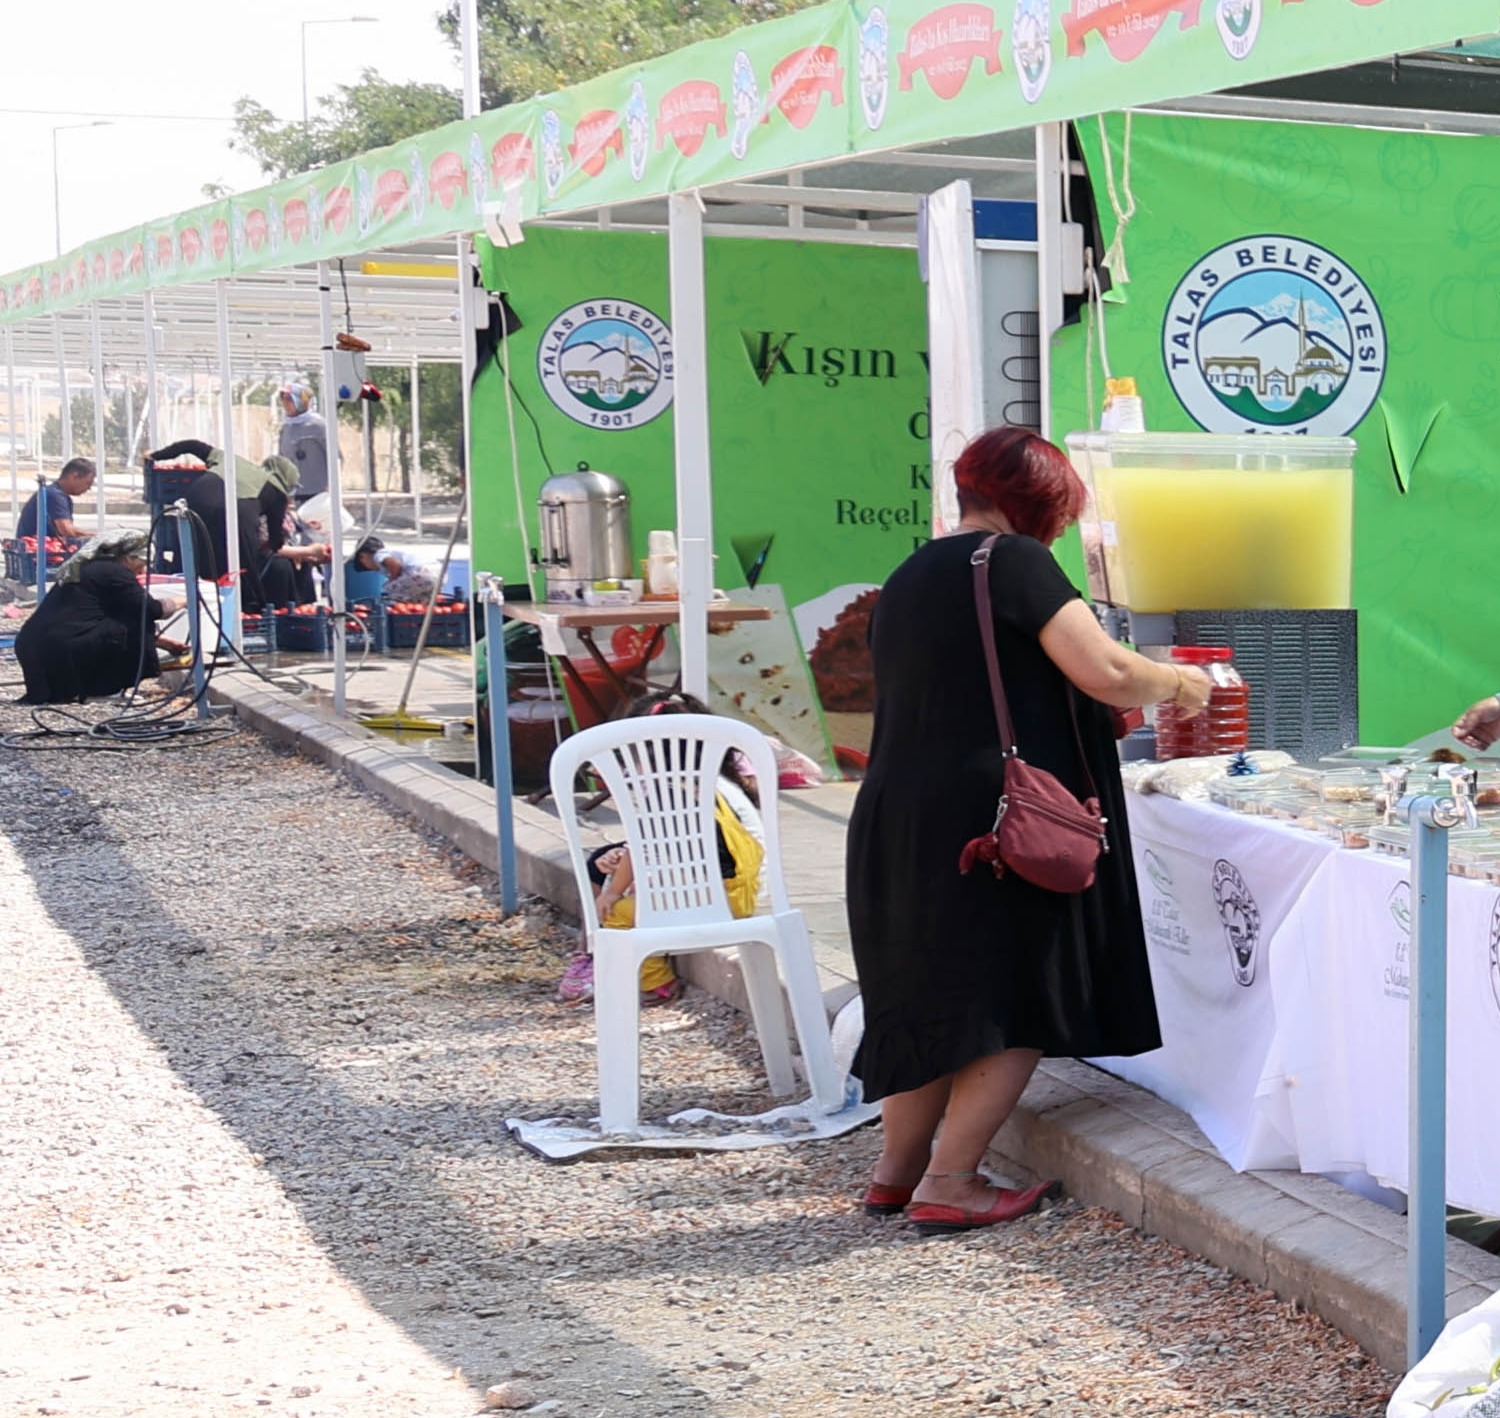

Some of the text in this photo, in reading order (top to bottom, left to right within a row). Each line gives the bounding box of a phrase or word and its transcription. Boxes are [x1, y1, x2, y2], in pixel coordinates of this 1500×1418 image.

[1171, 245, 1381, 373] TALAS BELEDİYESİ
[543, 316, 574, 378] TALAS
[757, 331, 897, 388] Kışın
[589, 411, 634, 427] 1907
